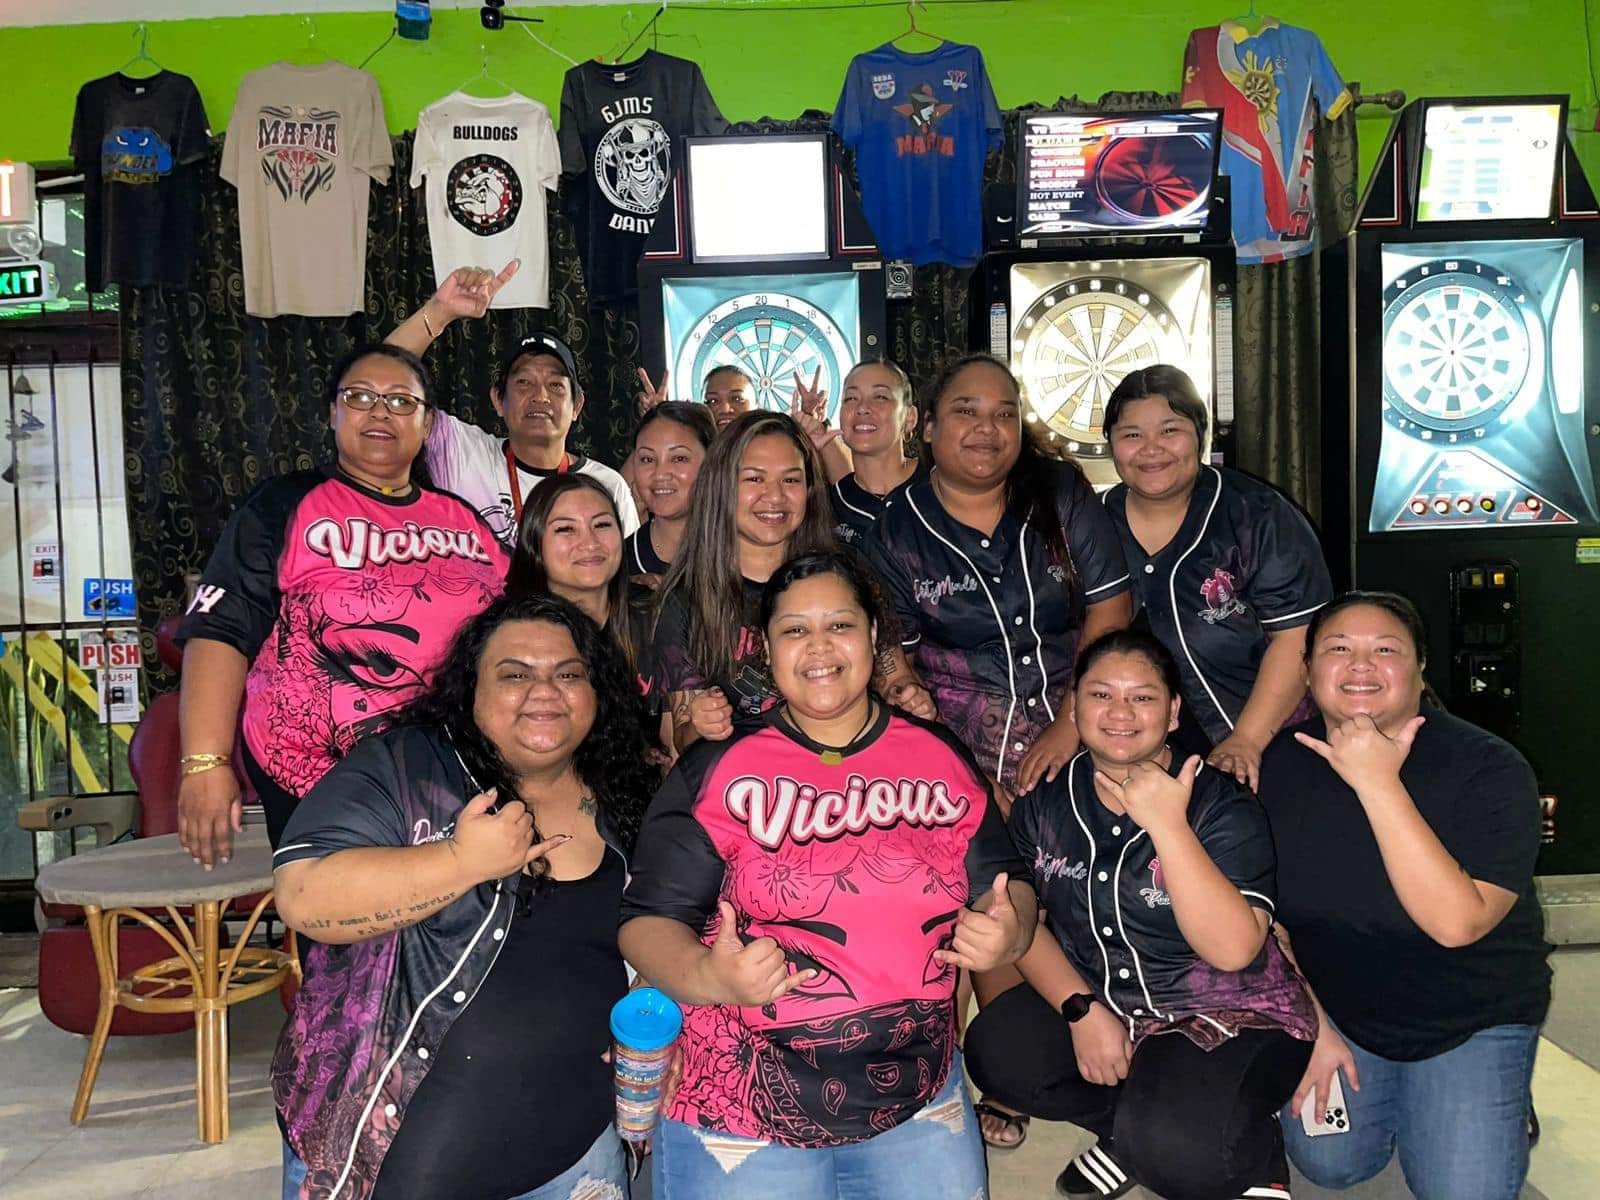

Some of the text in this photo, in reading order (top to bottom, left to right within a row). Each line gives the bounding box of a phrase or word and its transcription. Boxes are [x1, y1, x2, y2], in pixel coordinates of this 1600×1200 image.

[257, 117, 338, 155] MAFIA
[453, 125, 518, 142] BULLDOGS
[1030, 190, 1084, 200] HOT EVENT
[732, 300, 740, 311] 5
[755, 295, 768, 306] 20
[708, 314, 718, 324] 12
[35, 545, 57, 554] EXIT
[89, 581, 134, 594] PUSH
[724, 774, 970, 853] Vicious
